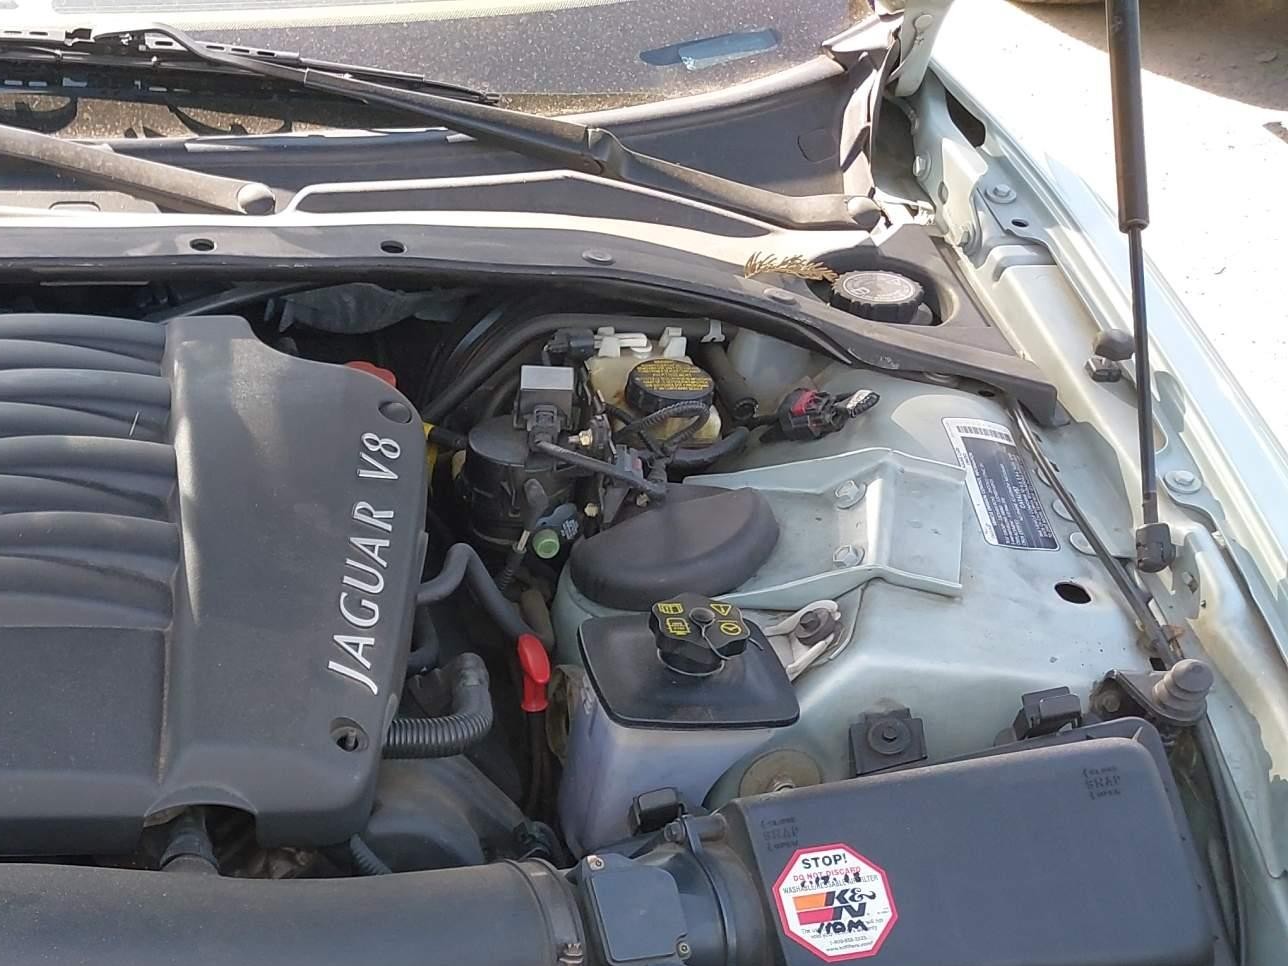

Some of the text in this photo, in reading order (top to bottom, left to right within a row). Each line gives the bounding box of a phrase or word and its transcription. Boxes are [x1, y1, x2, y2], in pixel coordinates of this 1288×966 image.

[328, 432, 401, 696] JAGUAR V8
[801, 853, 847, 869] STOP!
[793, 866, 861, 882] DO NOT DISCARD
